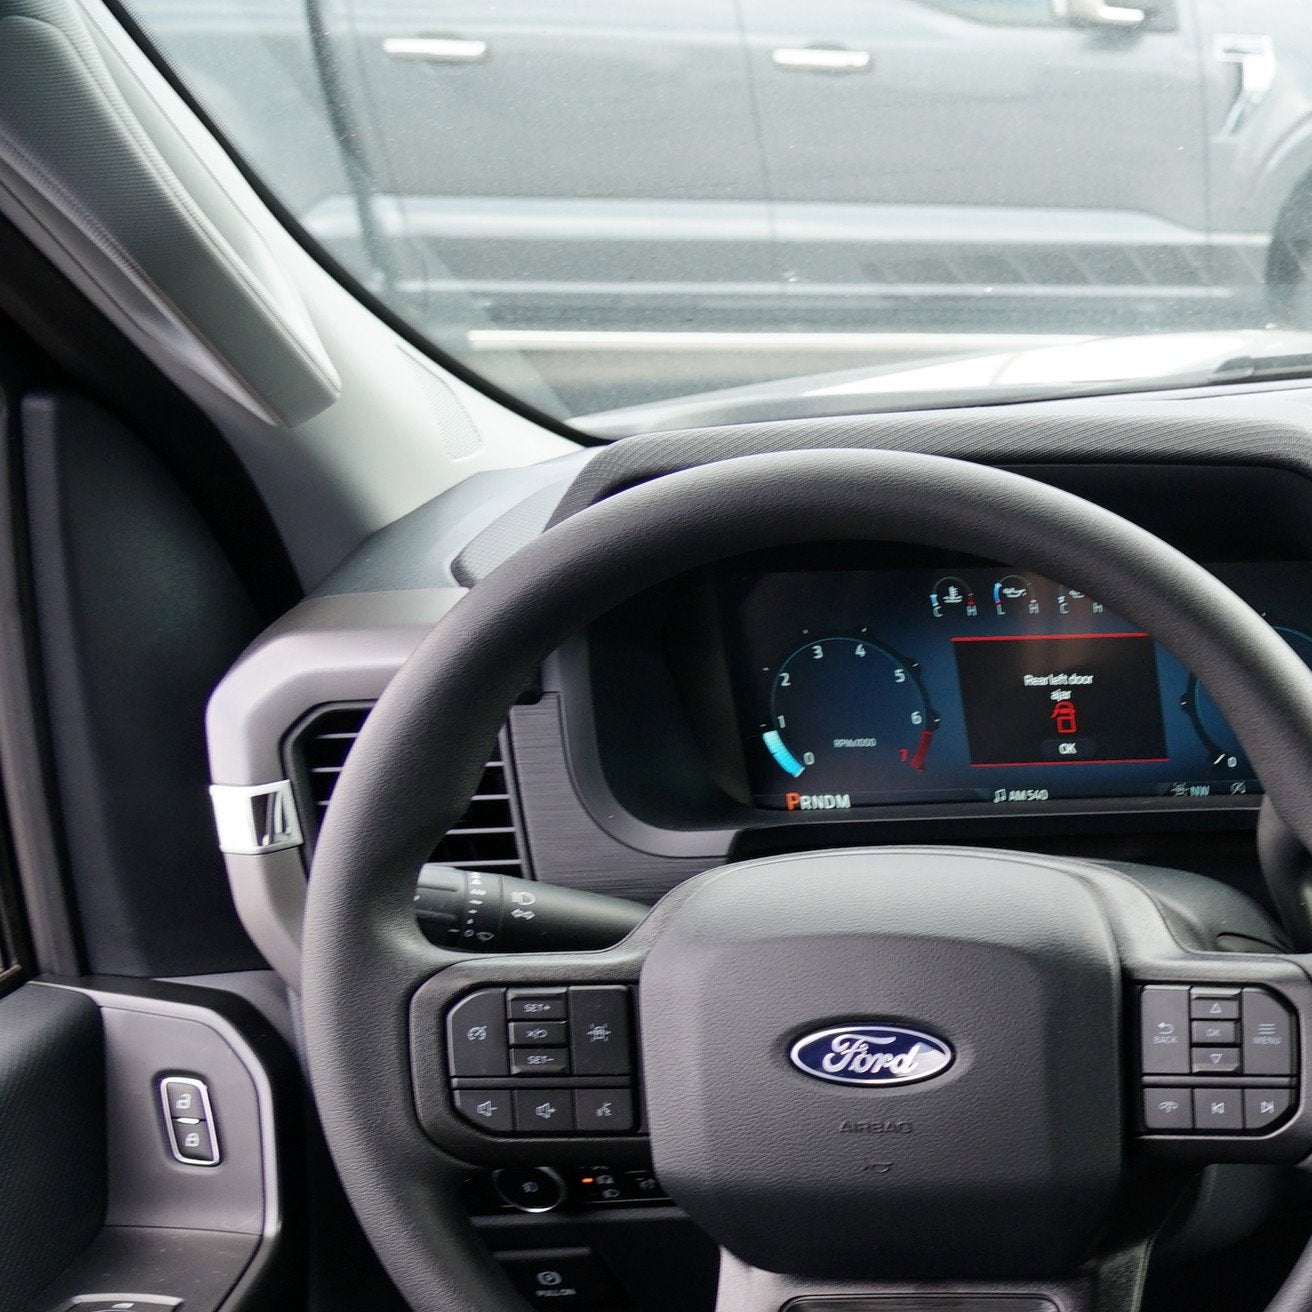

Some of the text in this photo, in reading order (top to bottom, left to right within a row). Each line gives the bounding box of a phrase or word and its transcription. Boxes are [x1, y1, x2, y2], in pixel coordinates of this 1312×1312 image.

[966, 605, 978, 617] H
[1028, 602, 1040, 615] H
[812, 644, 823, 659] 3
[855, 643, 866, 658] 4
[779, 672, 791, 687] 2
[894, 668, 906, 683] 5
[1023, 673, 1094, 686] Rear left door
[1050, 689, 1072, 702] ajar
[776, 714, 786, 729] 1
[910, 710, 922, 725] 6
[900, 748, 909, 763] 7
[1058, 742, 1078, 755] OK
[803, 751, 815, 766] 0
[1026, 789, 1049, 801] 540
[822, 1033, 923, 1074] Ford
